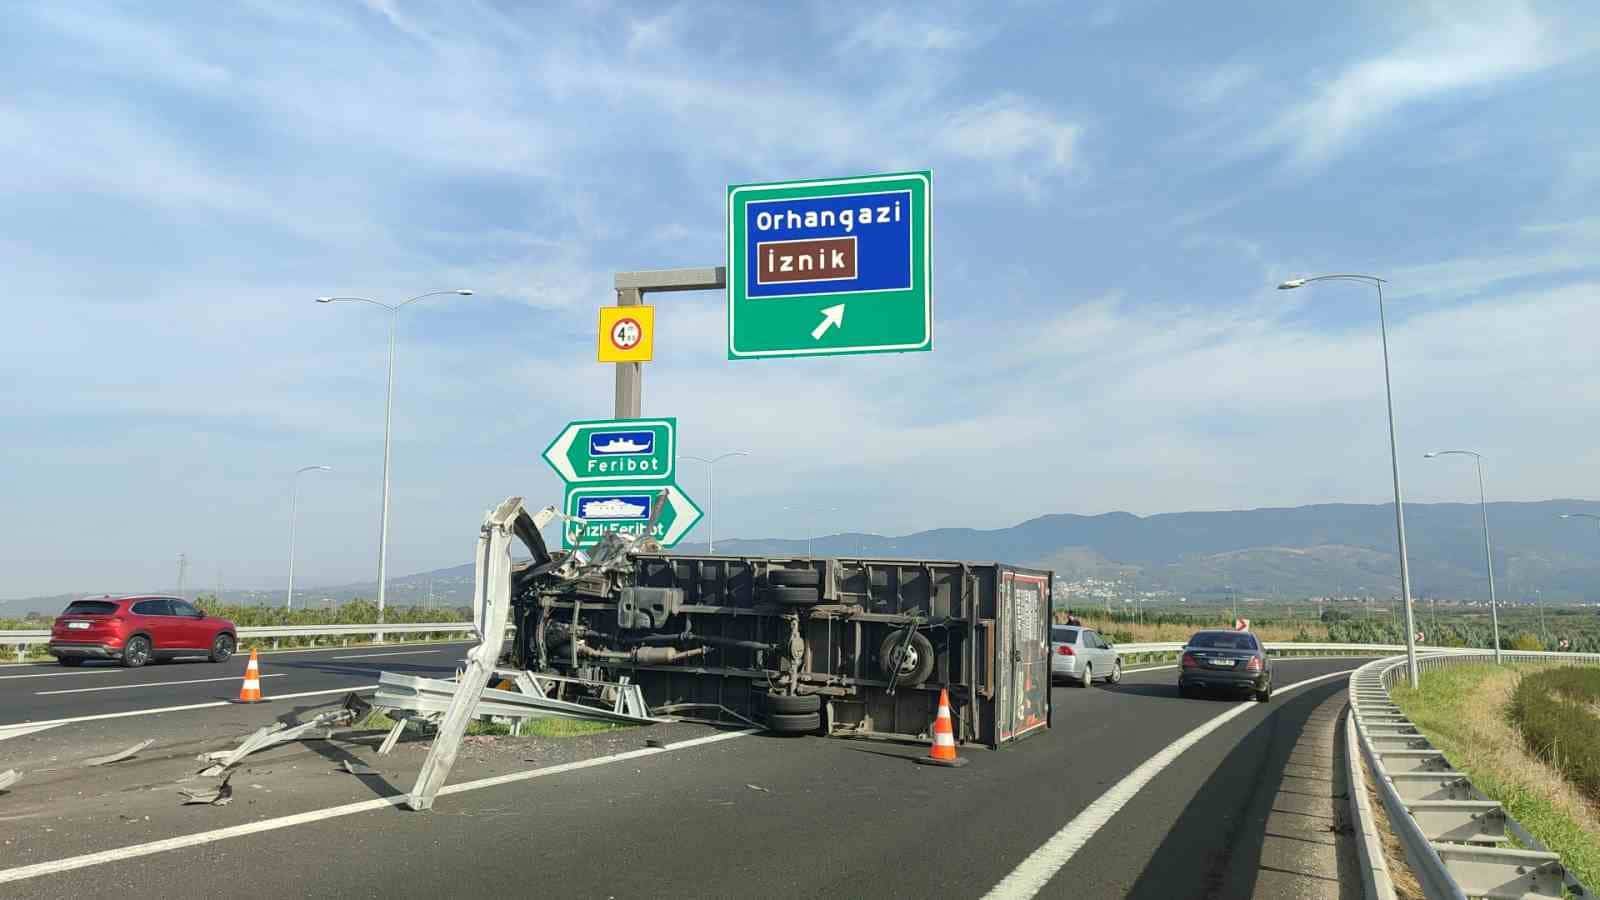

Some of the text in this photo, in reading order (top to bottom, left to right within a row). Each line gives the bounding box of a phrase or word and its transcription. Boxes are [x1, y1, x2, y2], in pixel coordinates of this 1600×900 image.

[756, 201, 901, 232] Orhangazi
[768, 248, 846, 273] İznik
[587, 458, 658, 473] Feribot
